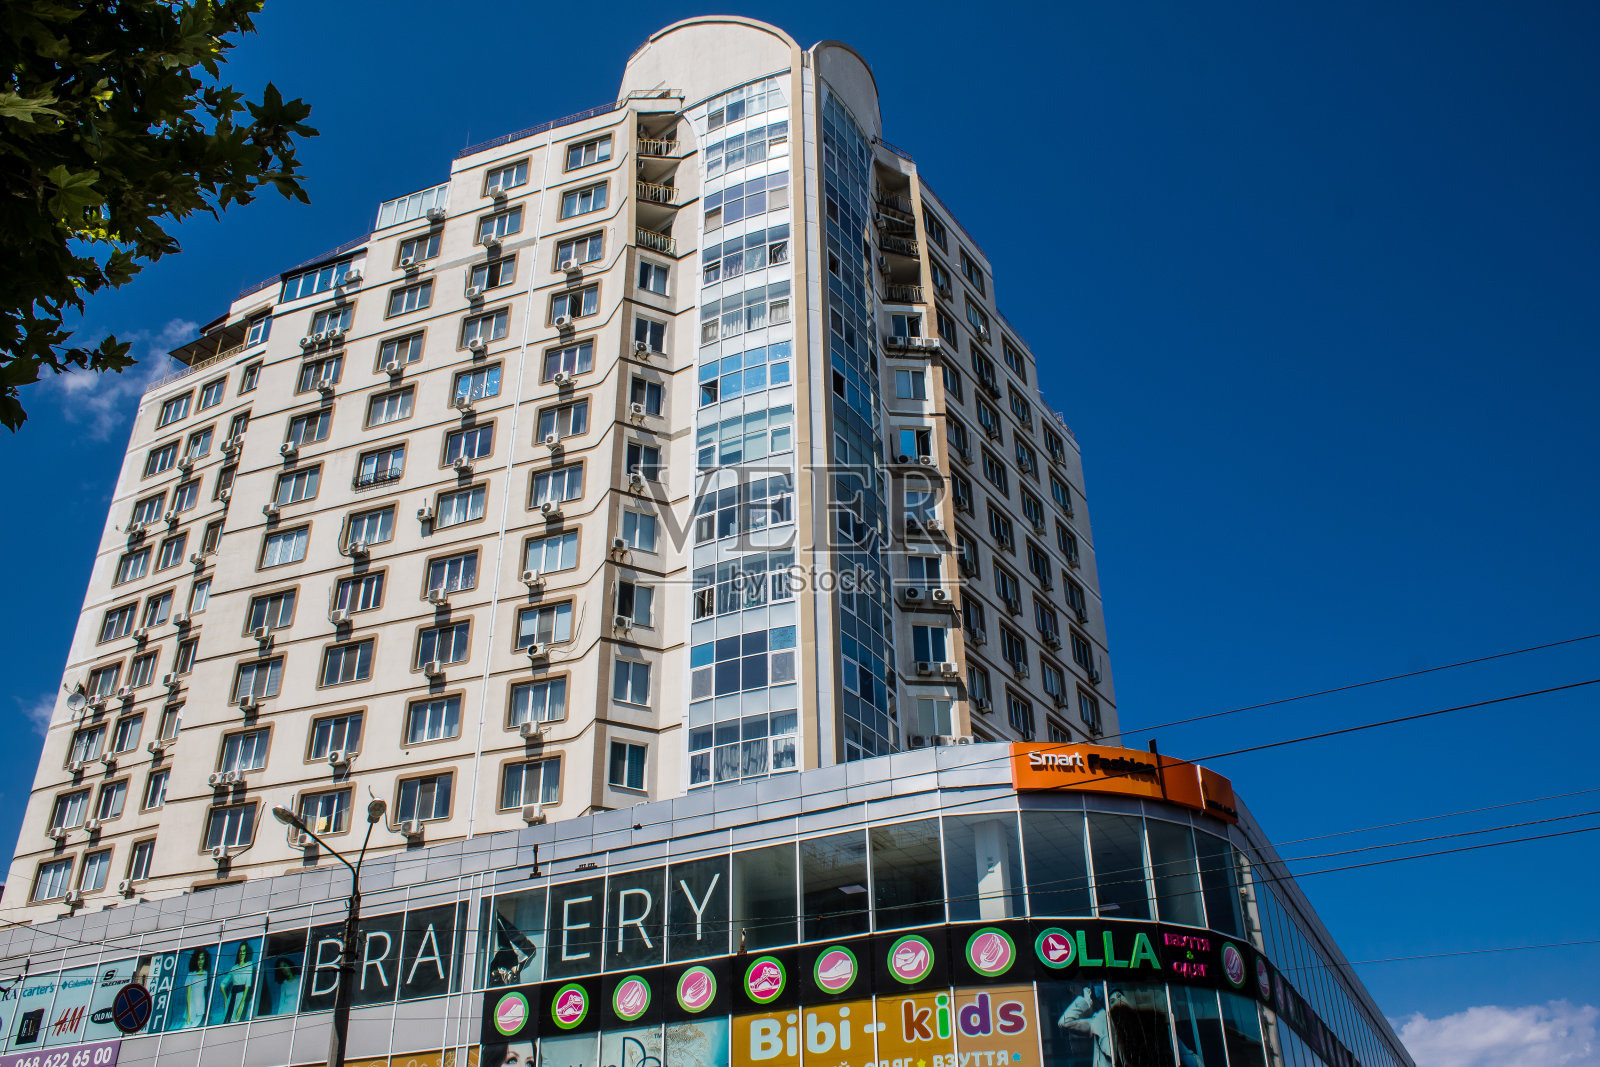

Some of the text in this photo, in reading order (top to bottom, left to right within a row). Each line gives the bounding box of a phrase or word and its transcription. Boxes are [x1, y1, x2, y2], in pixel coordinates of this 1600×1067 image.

[1028, 751, 1084, 767] Smart
[22, 983, 55, 998] carter's
[51, 1005, 86, 1037] H&M
[93, 1012, 105, 1021] OLD
[750, 1006, 851, 1061] Bibi
[901, 992, 1028, 1043] kids
[43, 1052, 69, 1067] 622
[72, 1050, 90, 1066] 65
[94, 1047, 112, 1065] 00
[932, 1050, 1009, 1067] ВЗУТТЯ
